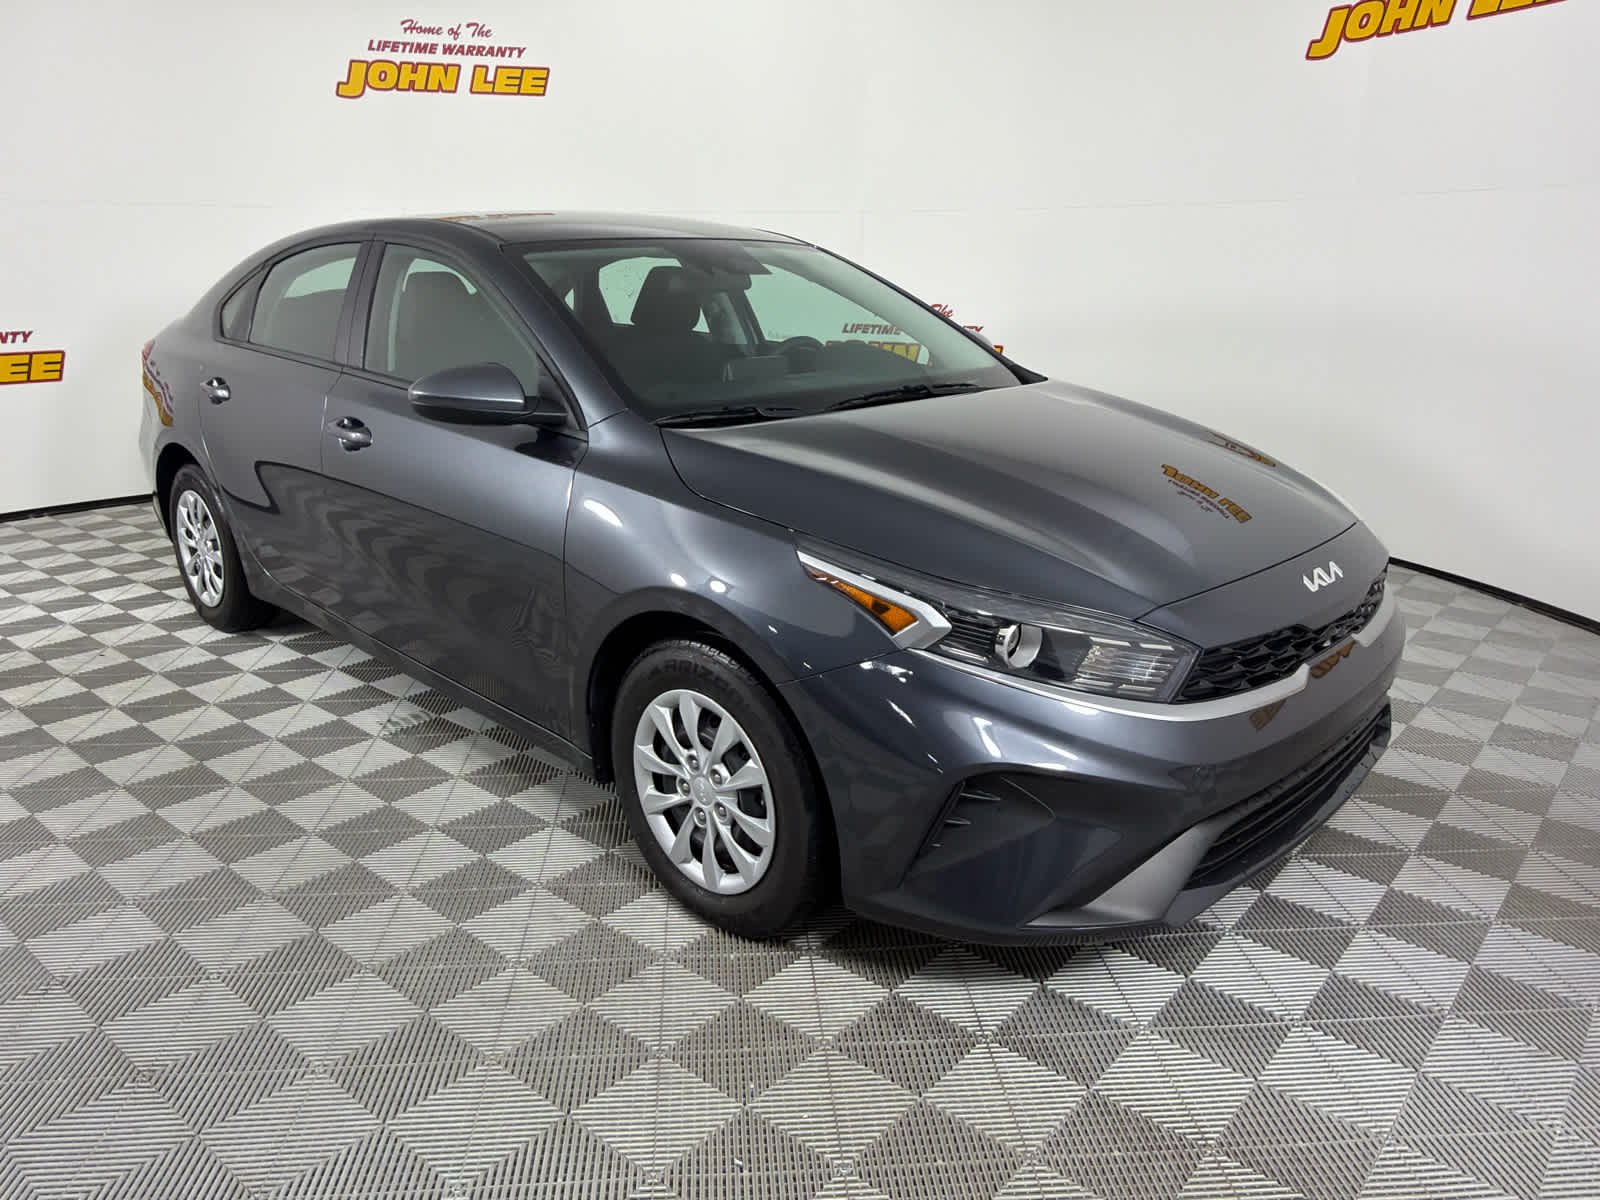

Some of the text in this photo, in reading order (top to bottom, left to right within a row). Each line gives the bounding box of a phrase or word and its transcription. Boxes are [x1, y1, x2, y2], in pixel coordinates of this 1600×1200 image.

[400, 18, 493, 40] Home of The
[368, 39, 527, 58] LIFETIME WARRANTY
[336, 59, 549, 99] JOHN LEE
